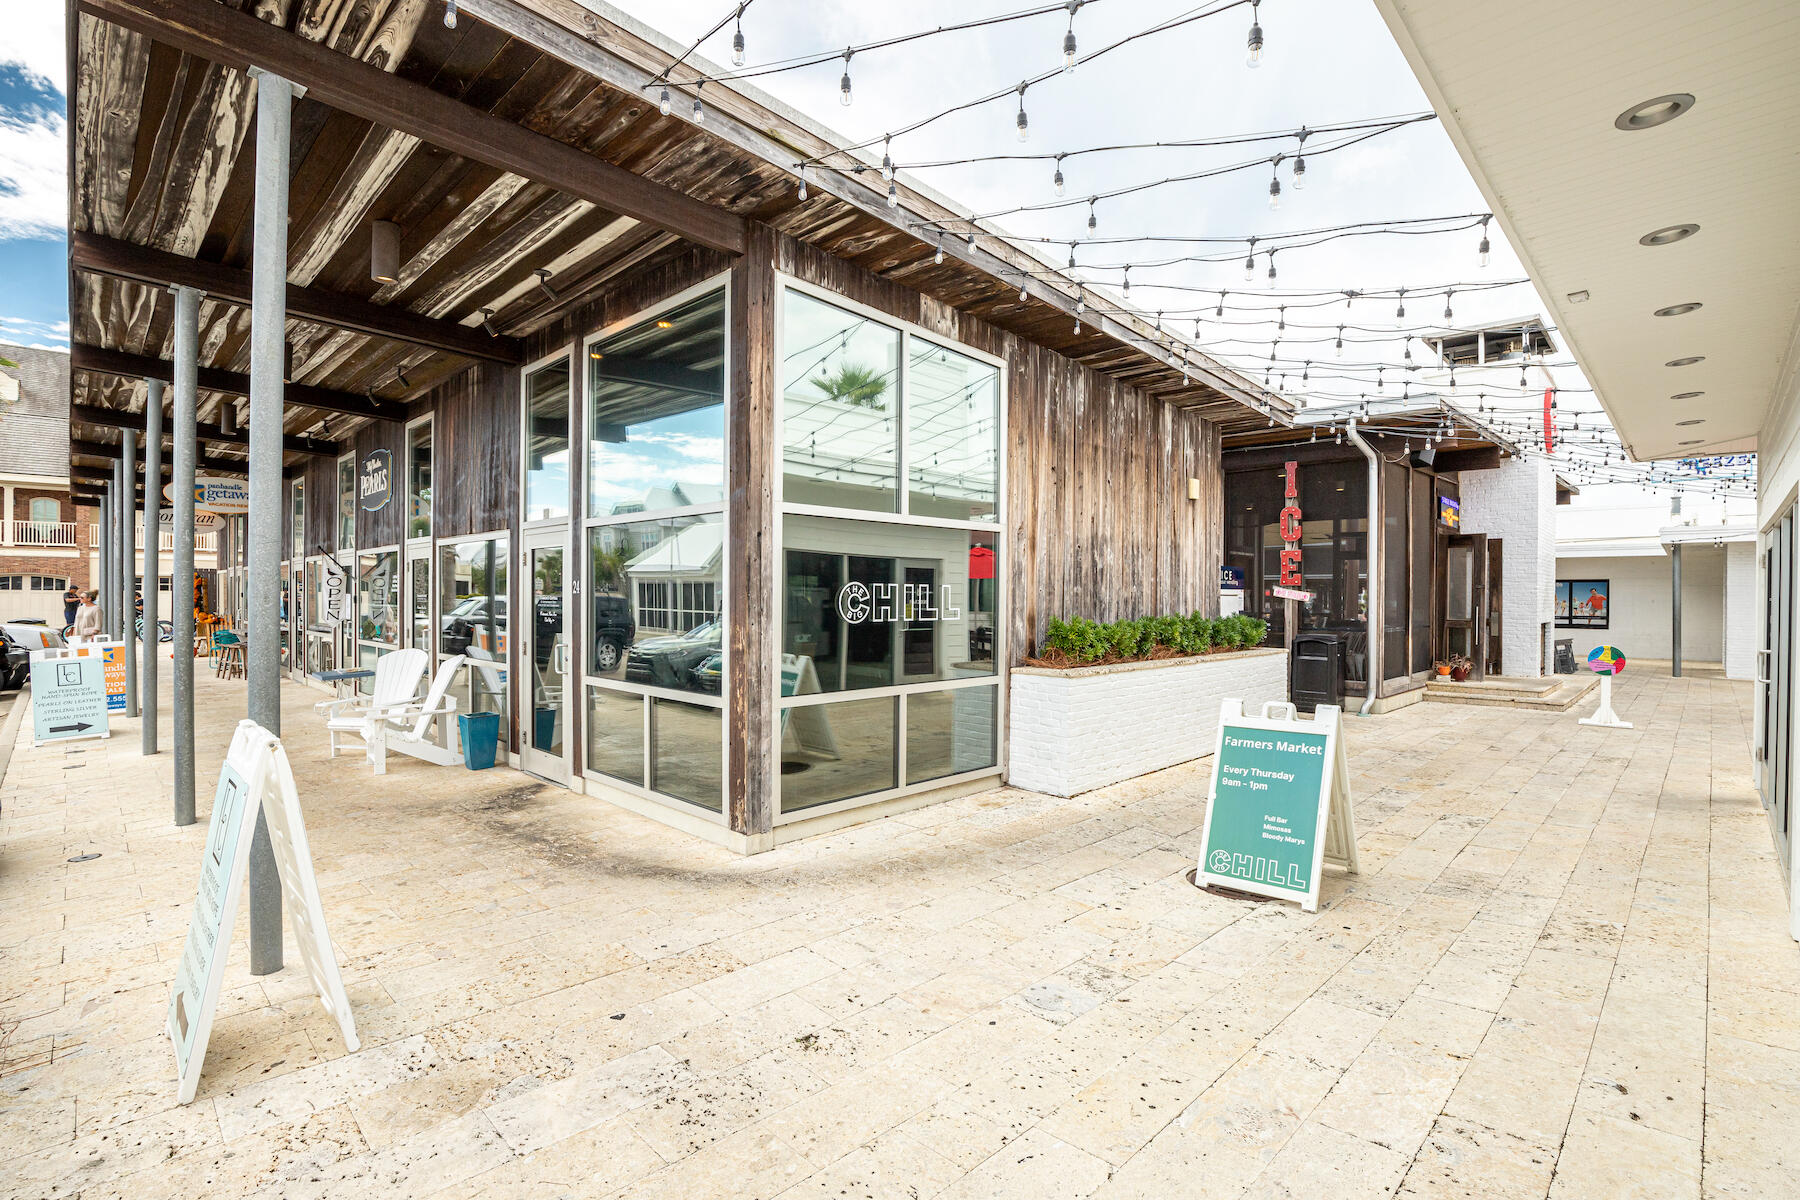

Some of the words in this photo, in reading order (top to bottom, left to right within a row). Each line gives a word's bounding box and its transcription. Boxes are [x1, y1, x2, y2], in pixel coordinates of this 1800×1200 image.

[360, 468, 387, 499] PEARLS
[1280, 461, 1302, 586] ICE
[572, 580, 582, 594] 24
[846, 584, 865, 597] THE
[327, 576, 343, 621] OPEN
[838, 581, 961, 624] CHILL
[846, 610, 863, 621] BIG
[1225, 736, 1274, 750] Farmers
[1276, 741, 1323, 755] Market
[1223, 764, 1249, 777] Every
[1250, 767, 1296, 782] Thursday
[1222, 777, 1242, 787] 9am
[1249, 780, 1268, 790] 1pm
[1264, 814, 1276, 823] Full
[1276, 815, 1289, 824] Bar
[1263, 823, 1292, 834] Mimosas
[1262, 832, 1285, 842] Bloody
[1284, 836, 1306, 845] Marys
[1209, 849, 1306, 889] CHILL
